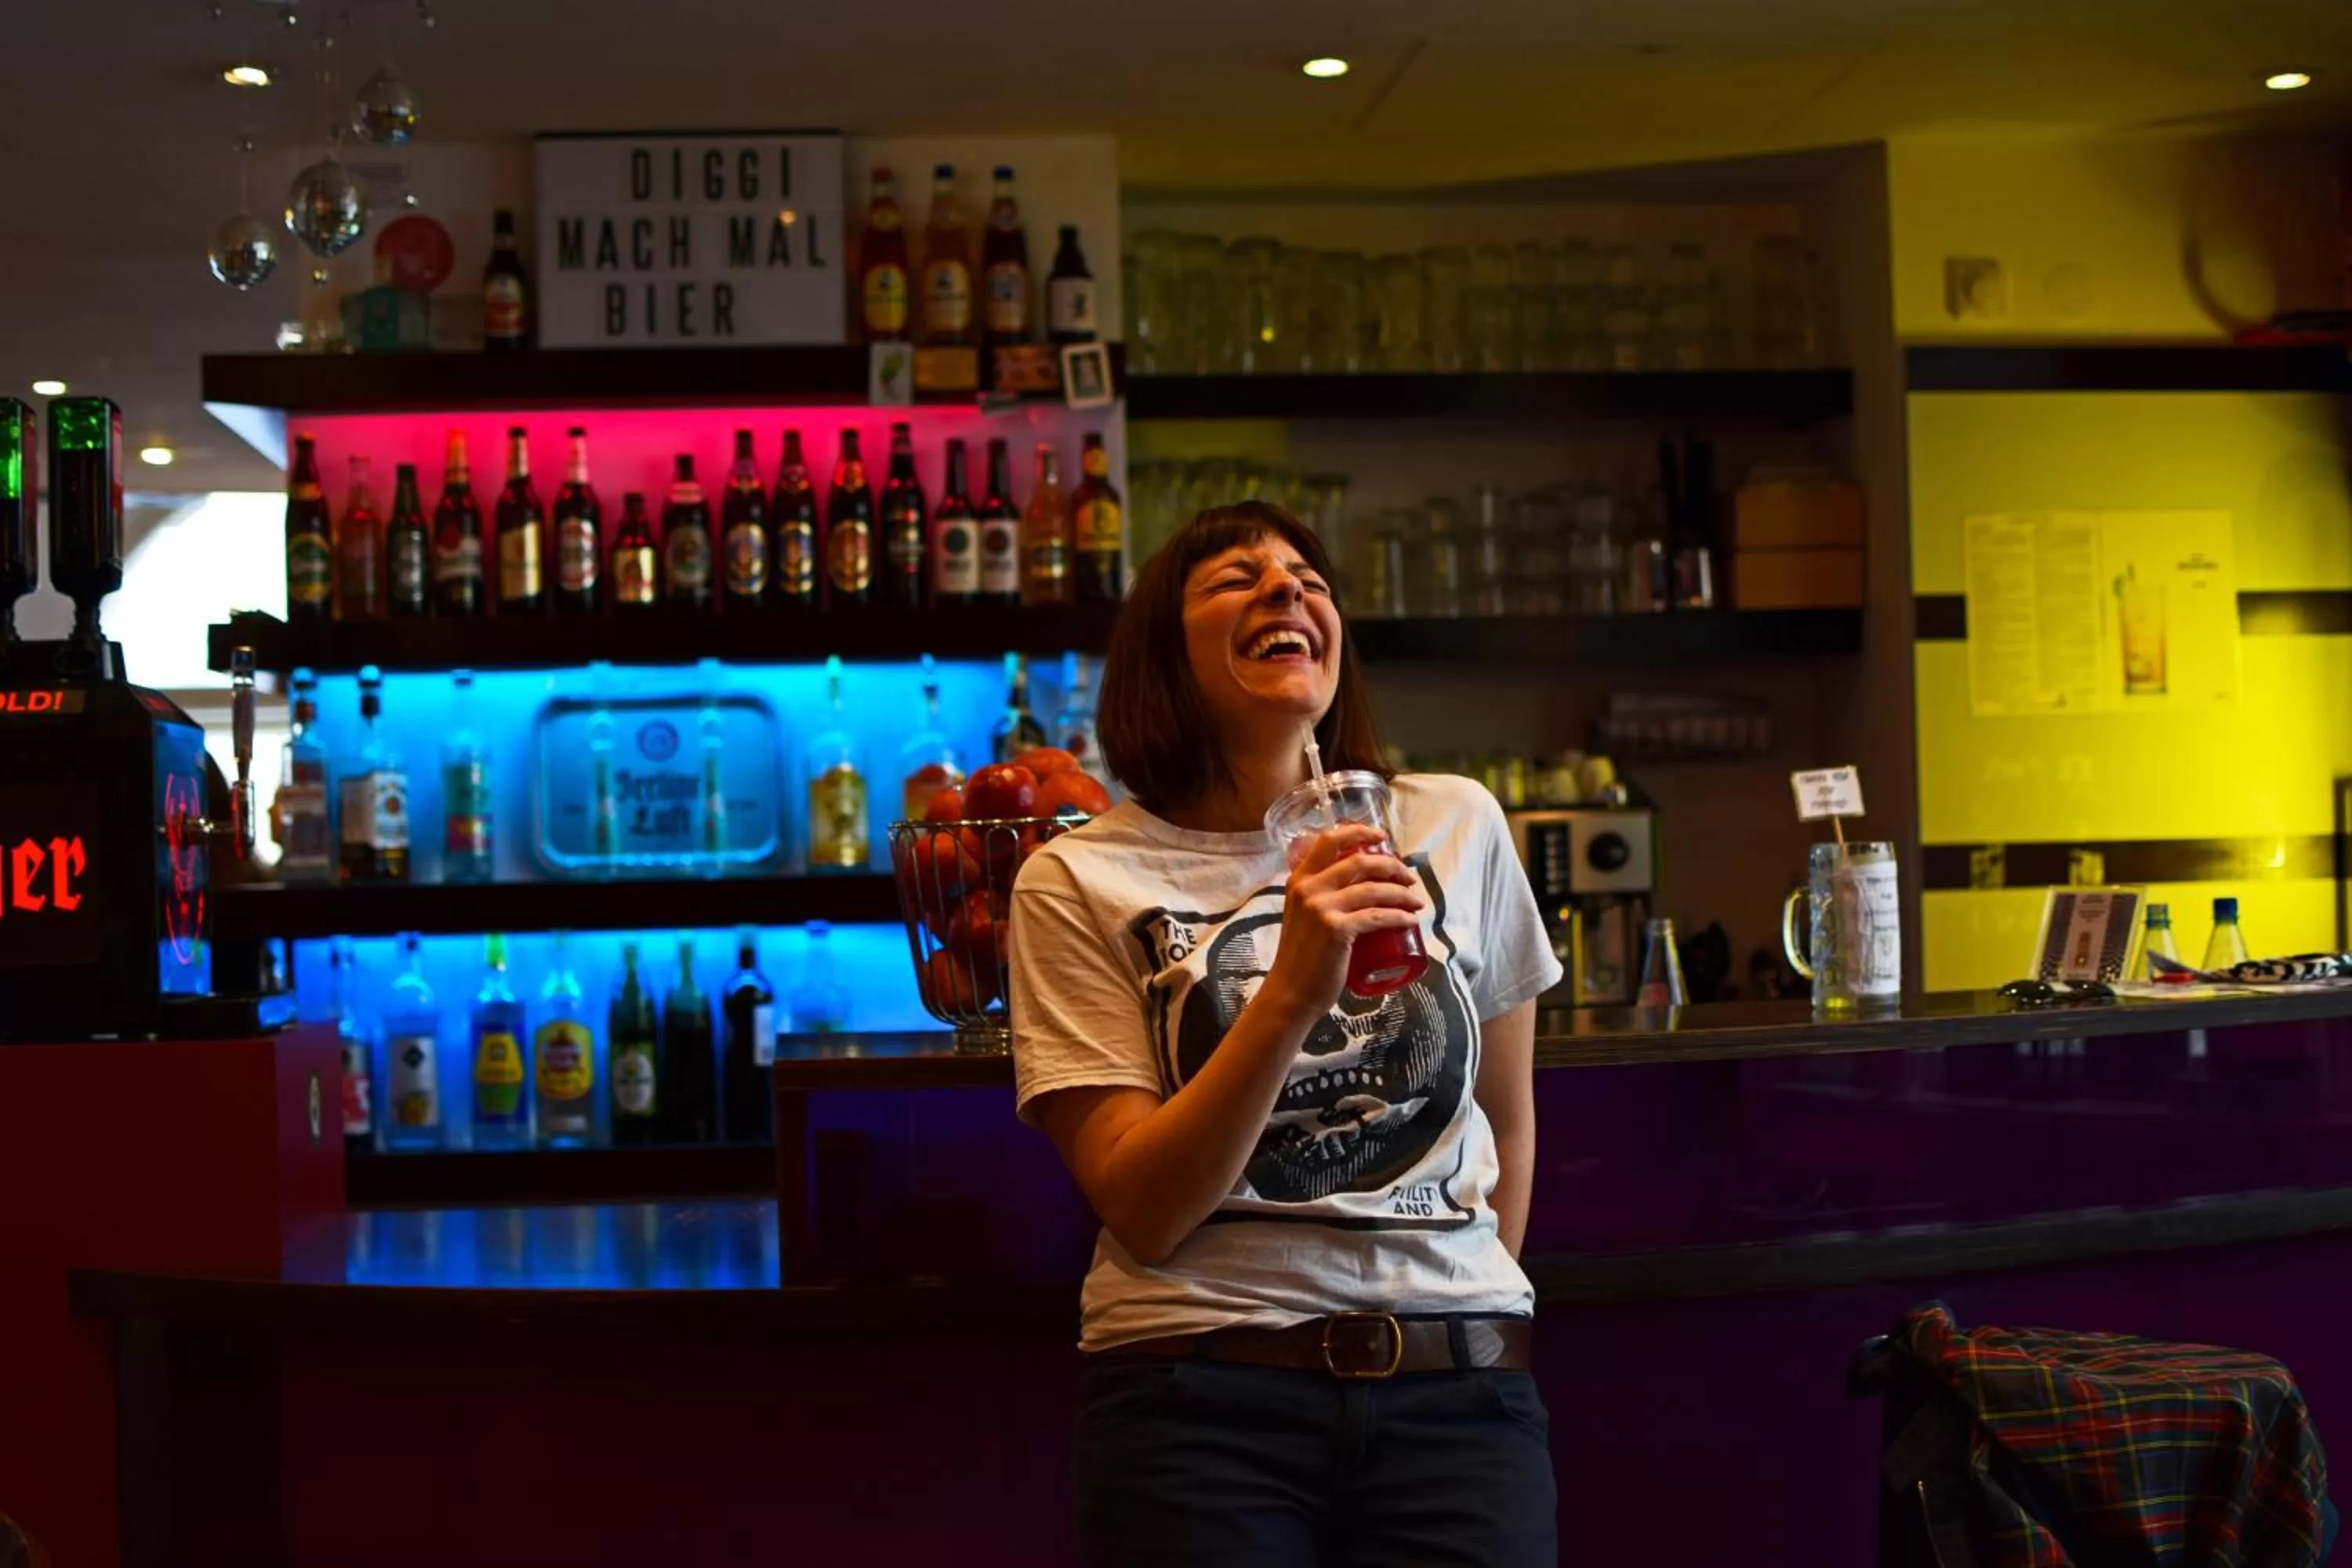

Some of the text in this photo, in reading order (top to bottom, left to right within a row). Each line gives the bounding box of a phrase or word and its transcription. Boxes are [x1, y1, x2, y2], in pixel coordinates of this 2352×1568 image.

[633, 147, 790, 201] DIGGI
[559, 214, 826, 270] MACH MAL
[605, 283, 735, 337] BIER
[0, 690, 64, 712] LD!
[0, 836, 87, 917] er
[1160, 920, 1197, 945] THE
[1394, 1201, 1433, 1216] AND
